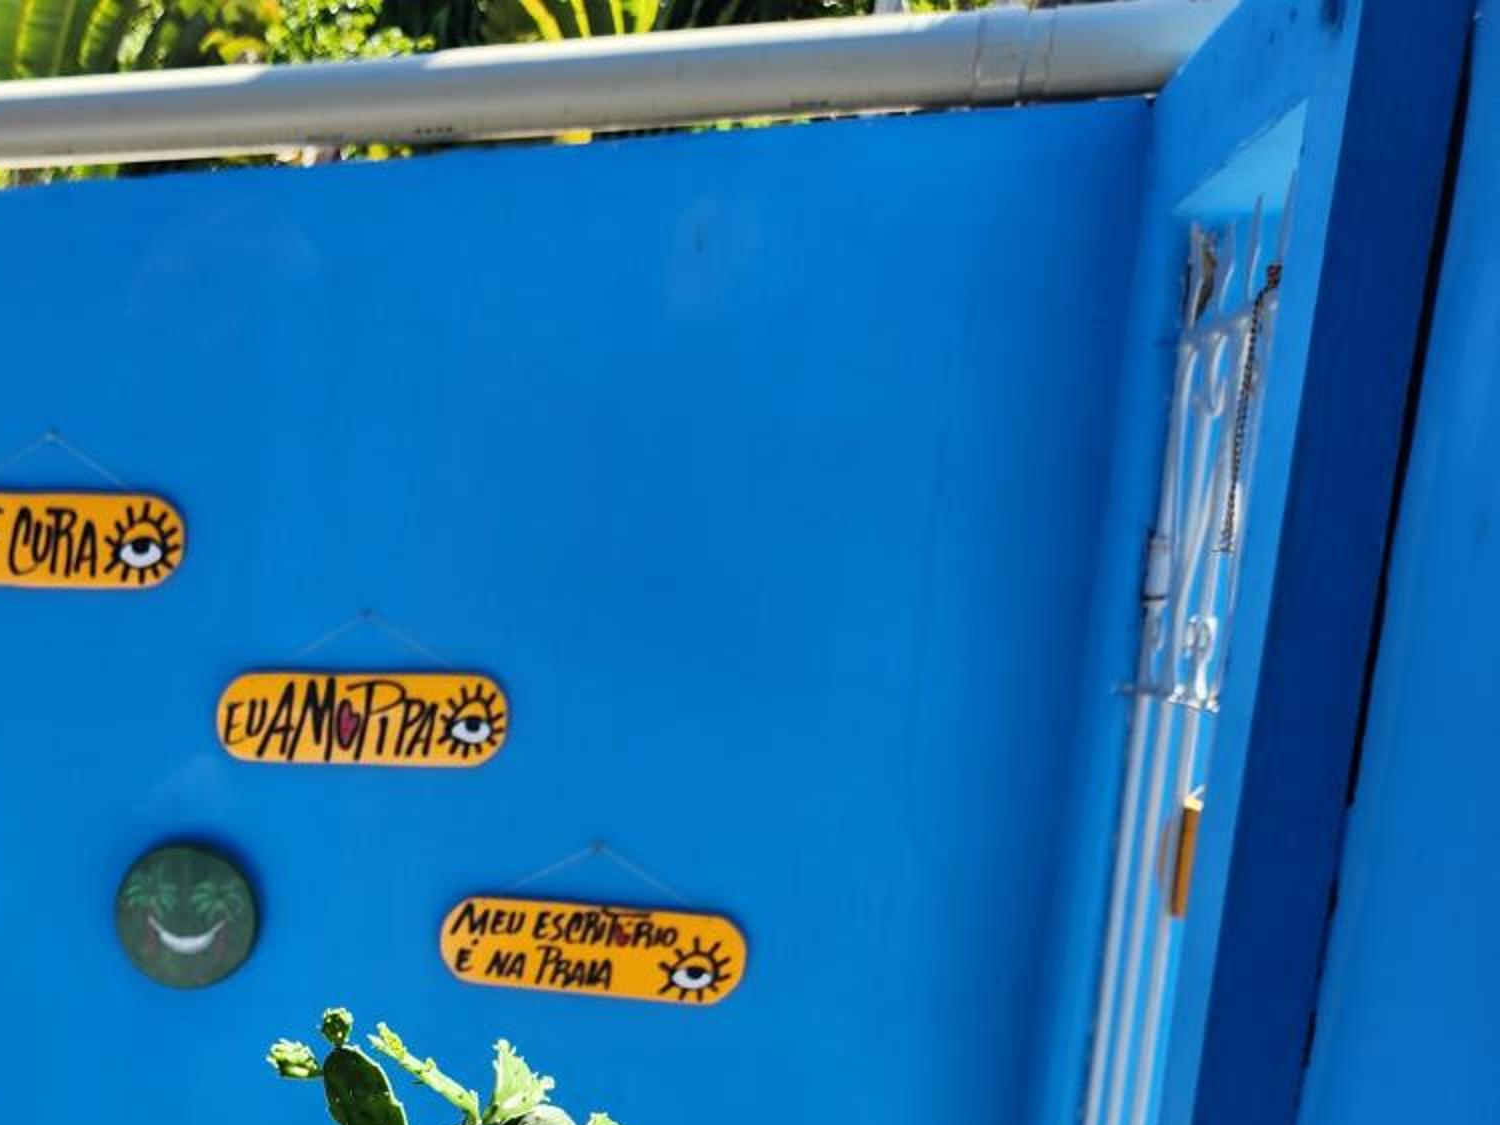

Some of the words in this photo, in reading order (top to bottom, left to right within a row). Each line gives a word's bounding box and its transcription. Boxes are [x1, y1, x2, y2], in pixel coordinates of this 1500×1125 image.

[8, 506, 97, 578] CURA
[223, 697, 268, 745] EU
[346, 679, 438, 761] PIPA
[451, 902, 526, 937] MEU
[455, 938, 480, 973] É
[485, 949, 527, 980] NA
[534, 945, 613, 991] PRAIA
